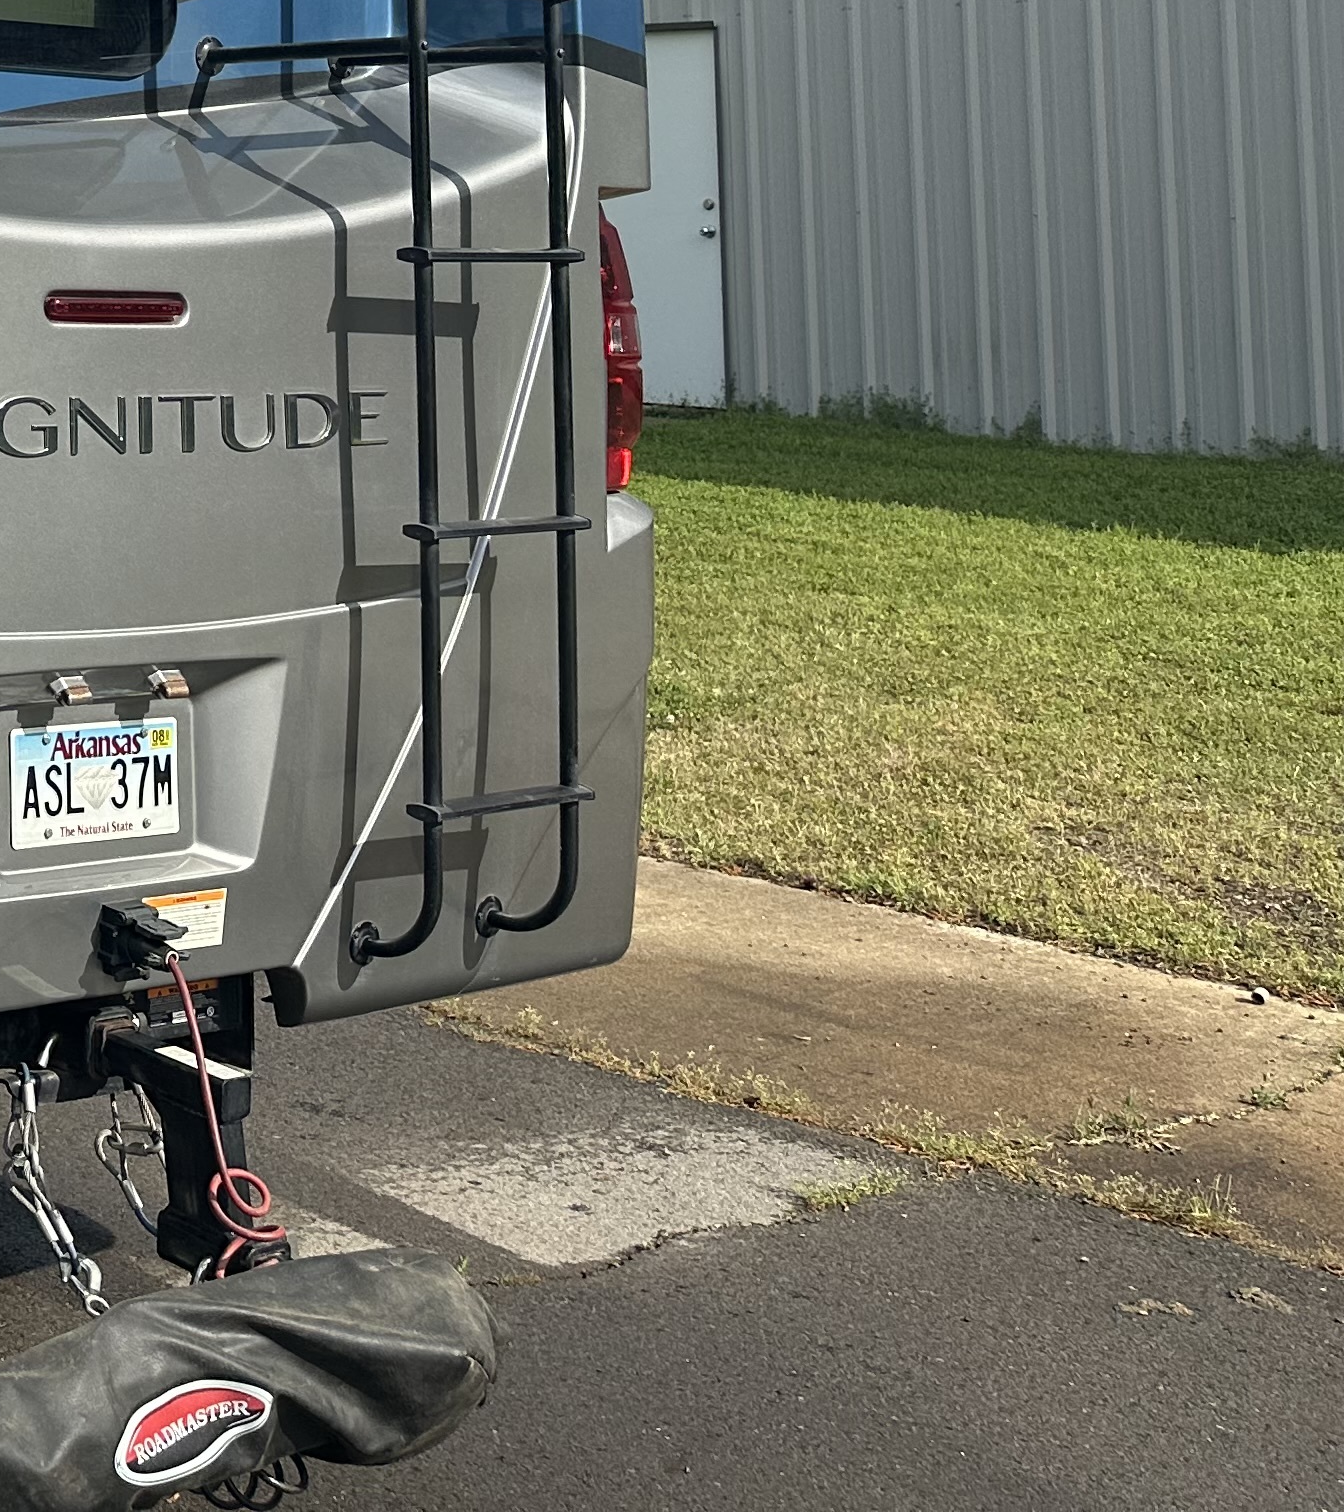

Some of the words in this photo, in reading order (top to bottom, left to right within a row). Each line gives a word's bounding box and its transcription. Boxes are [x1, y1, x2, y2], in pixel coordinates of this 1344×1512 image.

[50, 731, 141, 760] Arkansas
[23, 763, 85, 819] ASL
[110, 754, 173, 809] 37M
[60, 826, 75, 837] The
[76, 823, 109, 836] Natural
[111, 821, 133, 832] State
[133, 1399, 250, 1465] ROADMASTER
